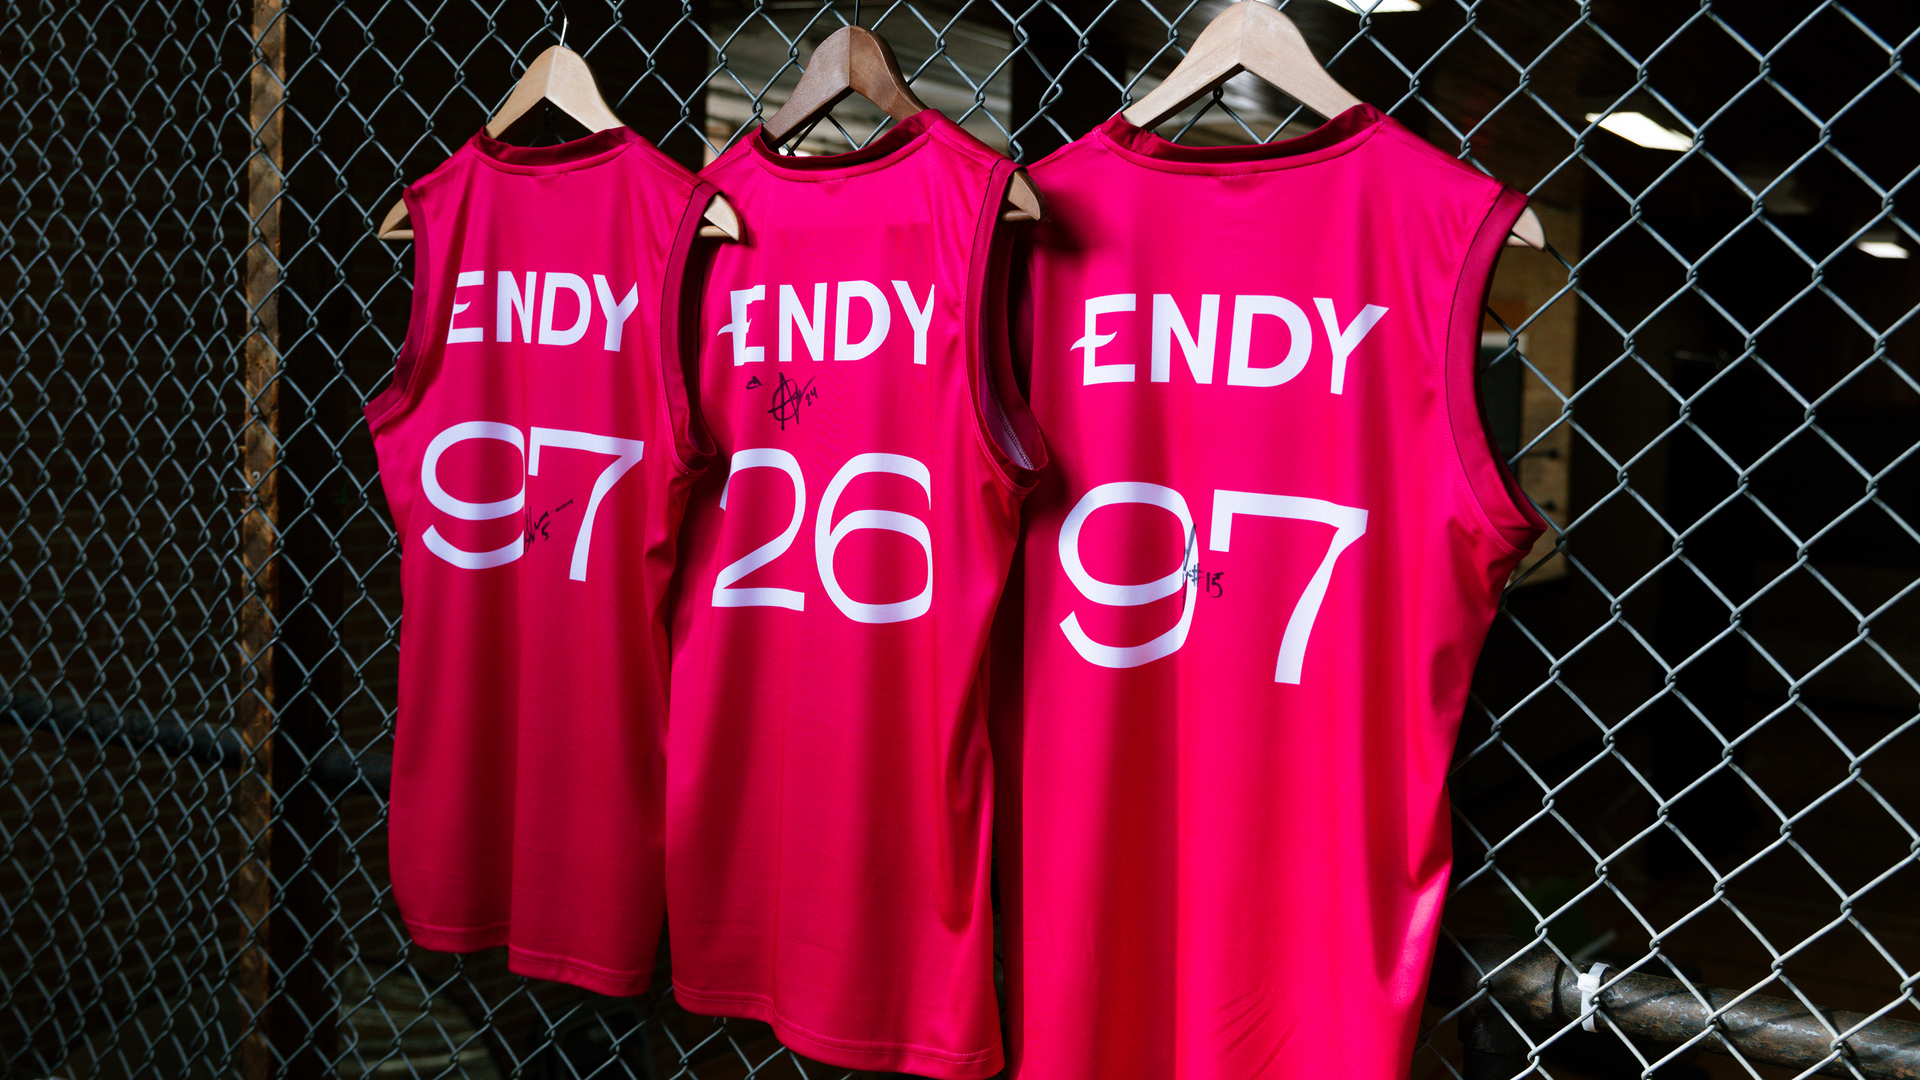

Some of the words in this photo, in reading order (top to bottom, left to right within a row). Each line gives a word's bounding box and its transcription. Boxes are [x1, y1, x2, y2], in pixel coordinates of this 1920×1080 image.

[446, 270, 639, 352] ENDY
[717, 280, 935, 366] ENDY
[1070, 293, 1390, 395] ENDY
[421, 421, 644, 582] 97
[711, 448, 934, 624] 26
[1058, 481, 1369, 685] 97
